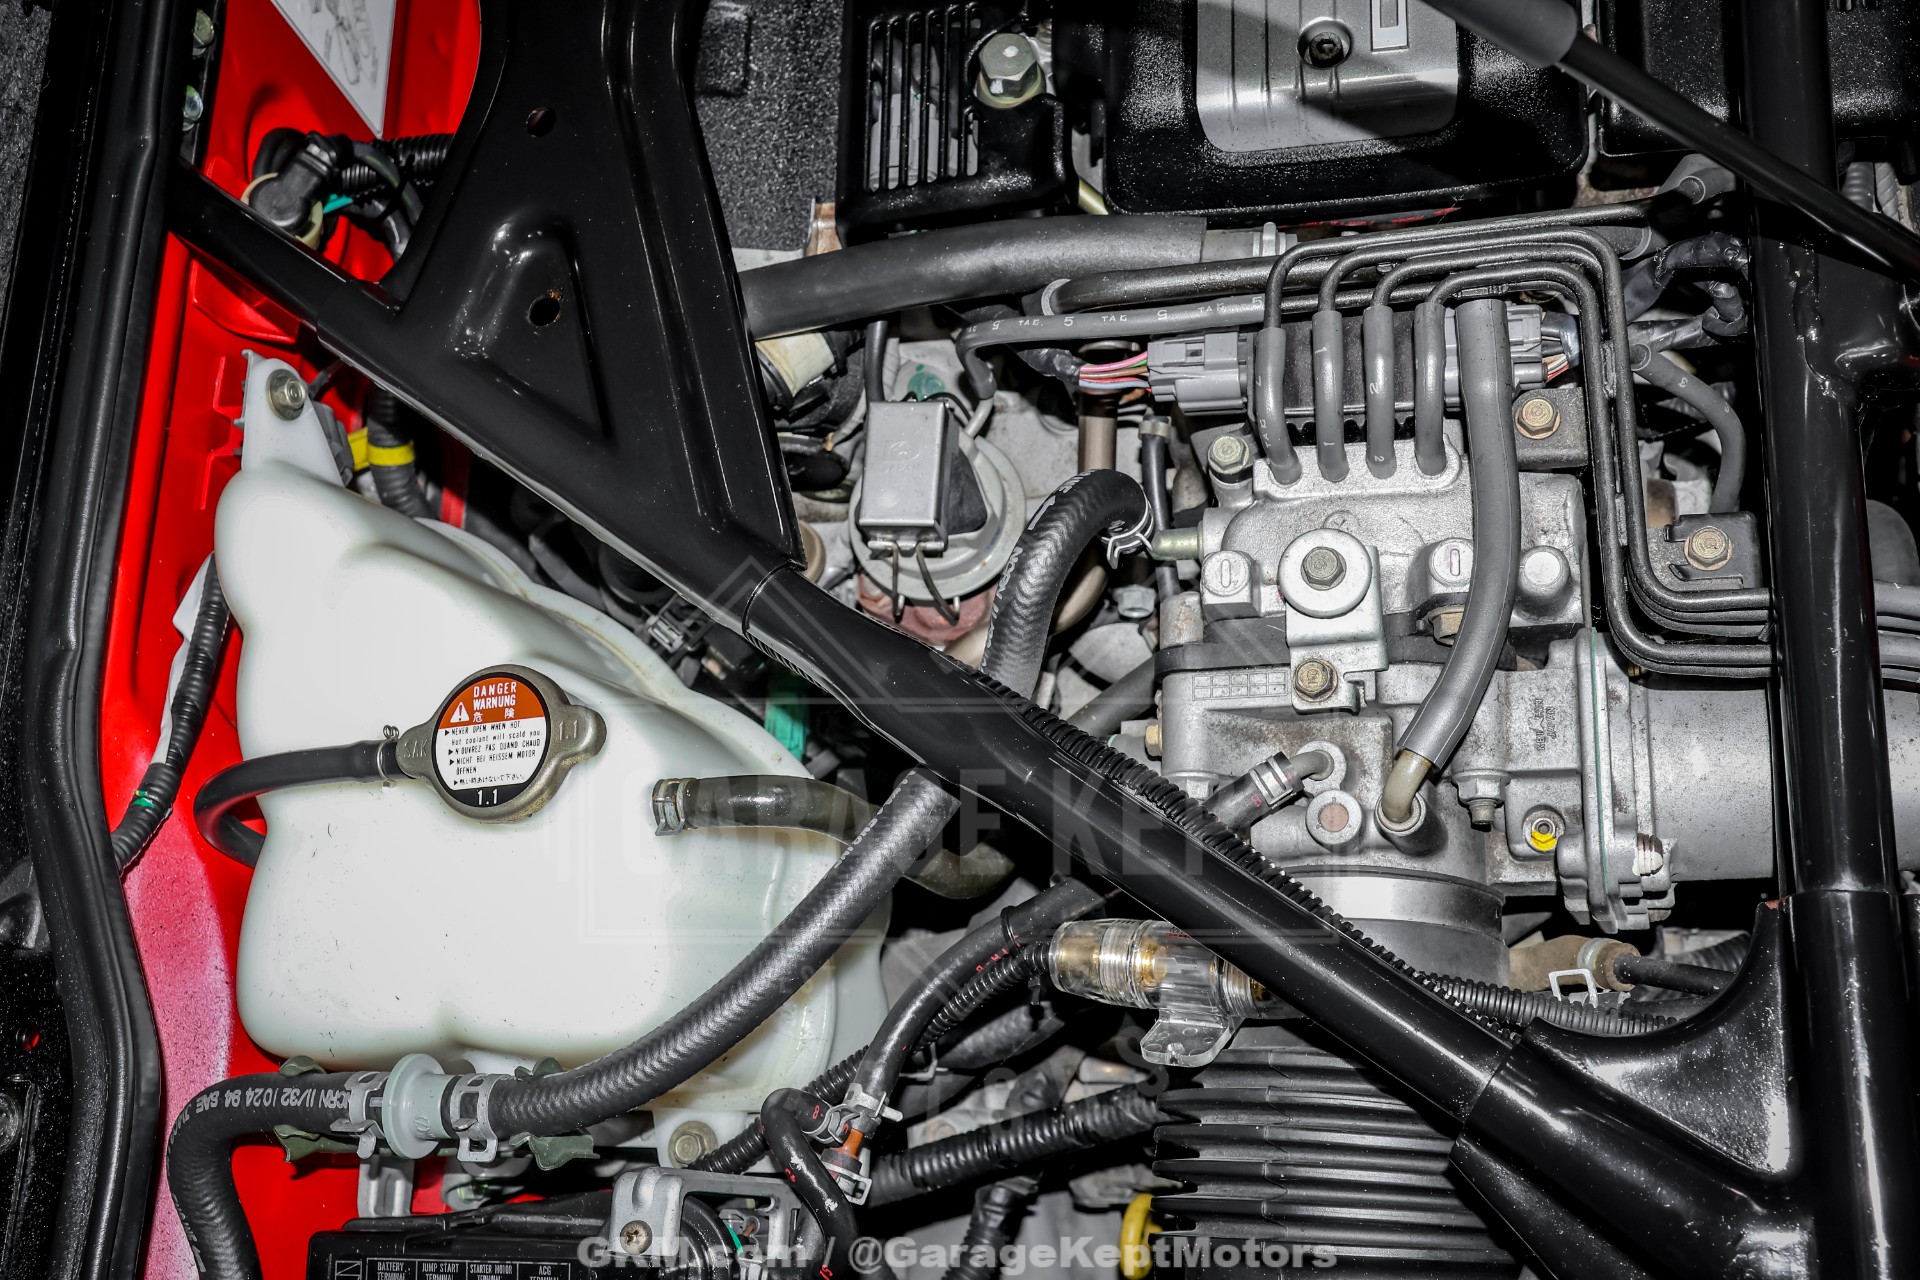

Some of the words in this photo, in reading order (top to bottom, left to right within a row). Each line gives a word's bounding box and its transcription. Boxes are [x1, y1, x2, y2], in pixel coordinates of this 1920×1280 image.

[1063, 316, 1075, 327] 5
[473, 681, 517, 698] DANGER
[473, 695, 516, 711] WARNUNG
[451, 726, 469, 735] NEVER
[472, 724, 487, 733] OPEN
[490, 721, 506, 730] WHEN
[510, 720, 521, 729] HOT
[558, 719, 579, 741] 1.1
[466, 734, 489, 744] coolant
[492, 732, 505, 741] will
[508, 730, 526, 739] scald
[485, 743, 496, 752] PAS
[522, 738, 541, 748] CHAUD
[456, 756, 474, 766] NICHT
[476, 753, 486, 763] BEI
[488, 751, 513, 762] HEISSEM
[516, 749, 536, 760] MOTOR
[477, 788, 498, 806] 1.1
[422, 1262, 438, 1273] JUMP
[439, 1263, 460, 1273] START
[469, 1264, 493, 1274] STARTER
[538, 1265, 552, 1276] ACG
